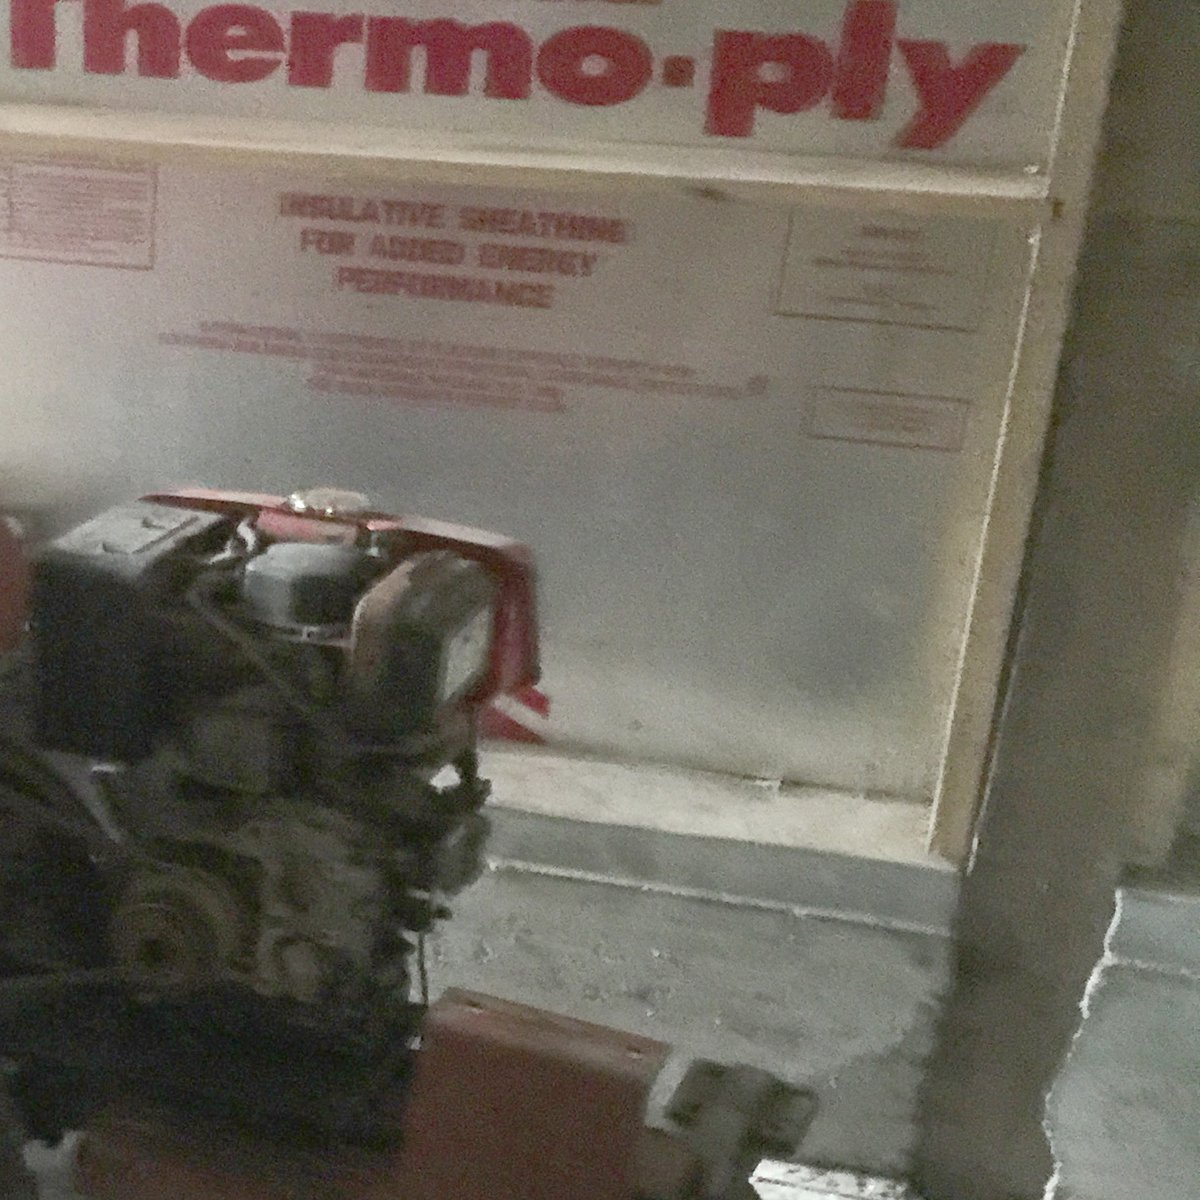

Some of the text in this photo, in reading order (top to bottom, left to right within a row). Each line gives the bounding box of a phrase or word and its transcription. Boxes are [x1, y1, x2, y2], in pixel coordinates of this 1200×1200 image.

[300, 227, 354, 255] FOR
[369, 233, 466, 265] ADDED
[337, 266, 555, 308] PERFORMANCE
